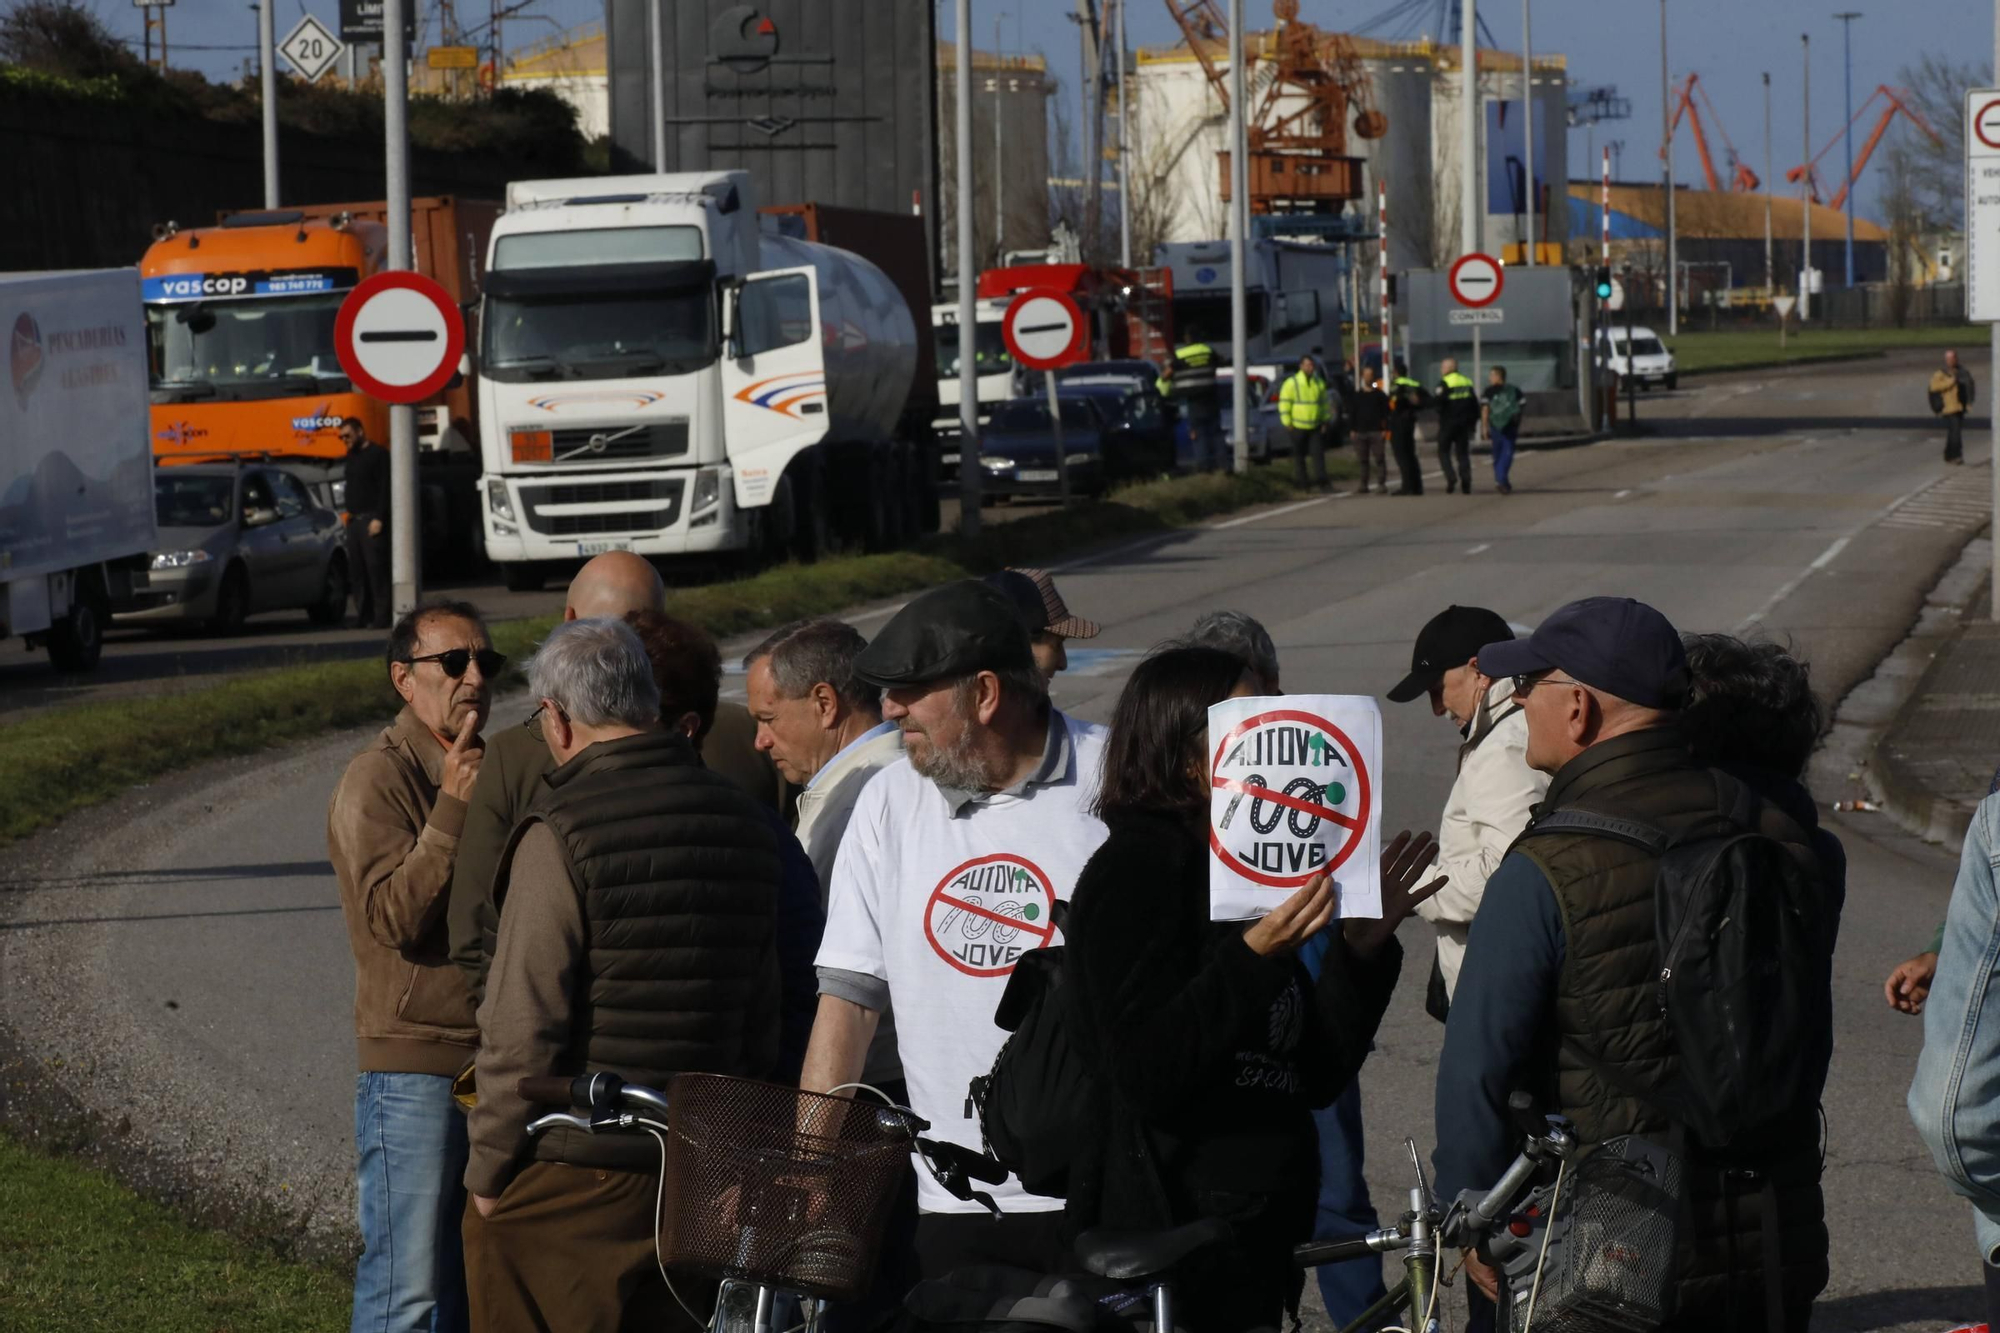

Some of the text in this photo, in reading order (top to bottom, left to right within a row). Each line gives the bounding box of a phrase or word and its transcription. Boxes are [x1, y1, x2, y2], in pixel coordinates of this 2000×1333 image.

[299, 39, 322, 59] 20
[162, 276, 247, 295] vascop
[1450, 311, 1500, 322] CONTROL
[292, 416, 343, 430] vascop
[1239, 843, 1325, 873] JOVE
[953, 943, 1022, 966] JOVE
